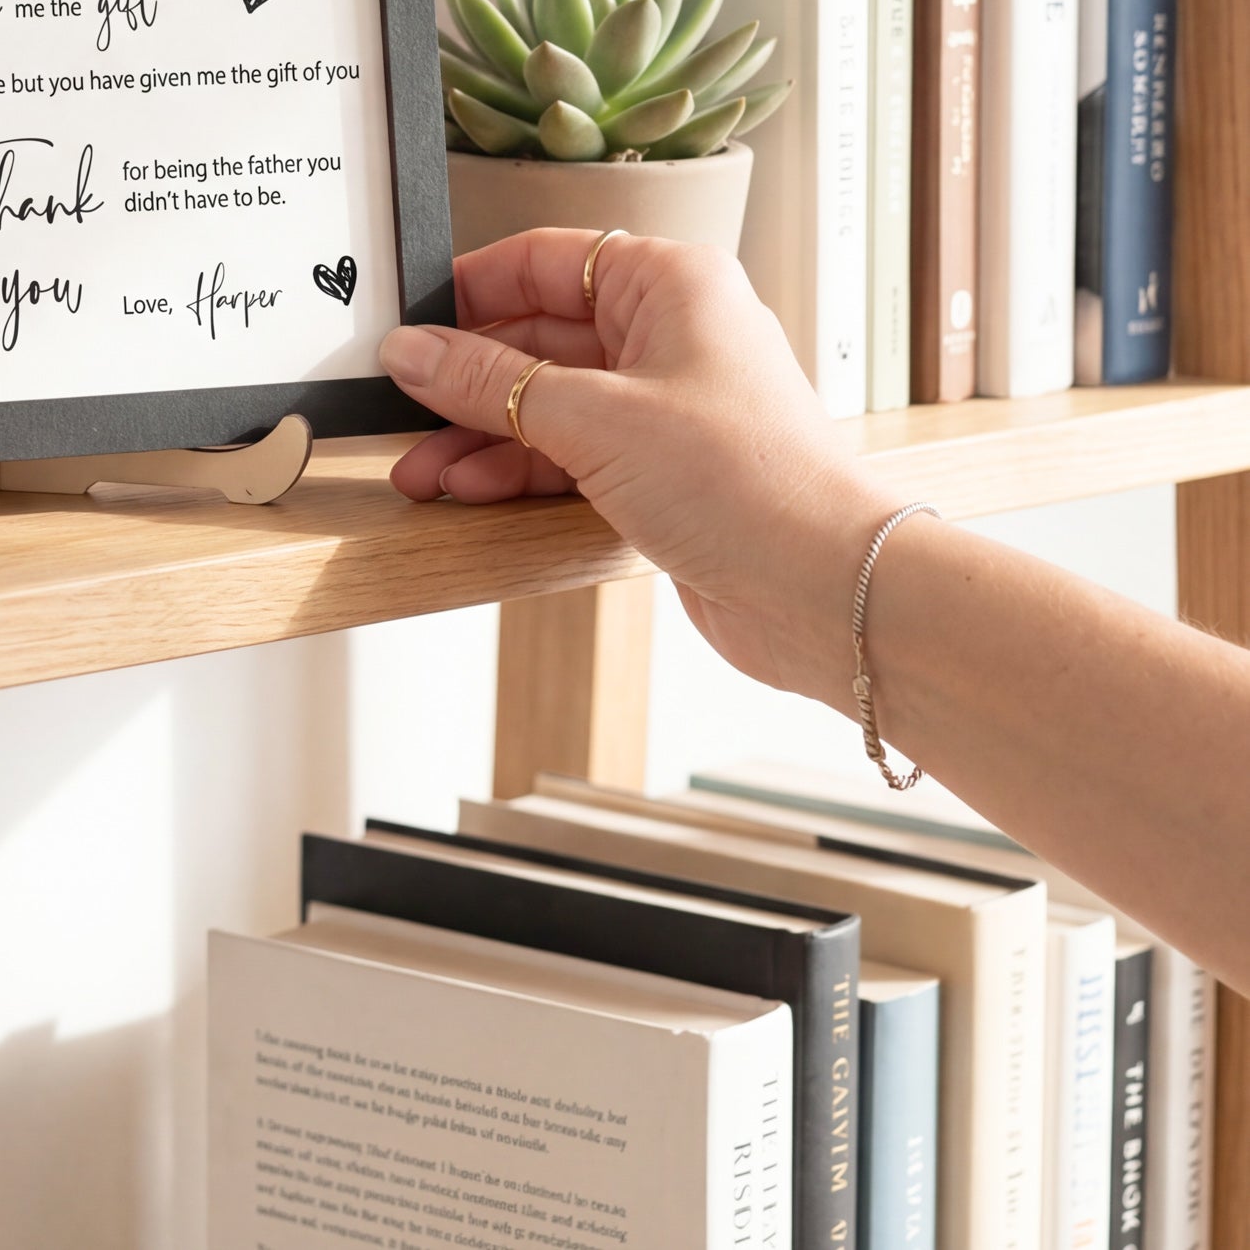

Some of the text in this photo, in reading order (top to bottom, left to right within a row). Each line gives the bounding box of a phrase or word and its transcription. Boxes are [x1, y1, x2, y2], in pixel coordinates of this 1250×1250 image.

[15, 2, 45, 19] me
[11, 72, 45, 94] but
[48, 76, 84, 98] you
[89, 69, 135, 90] have
[139, 68, 191, 94] given
[197, 70, 226, 86] me
[230, 63, 262, 85] the
[266, 61, 298, 89] gift
[302, 60, 322, 82] of
[325, 64, 360, 86] you
[122, 153, 341, 183] for being the father you
[184, 189, 231, 210] have
[235, 189, 253, 207] to
[257, 185, 286, 206] be.
[1, 269, 83, 352] you
[123, 261, 283, 341] Love, Harper
[1124, 1060, 1146, 1130] THE
